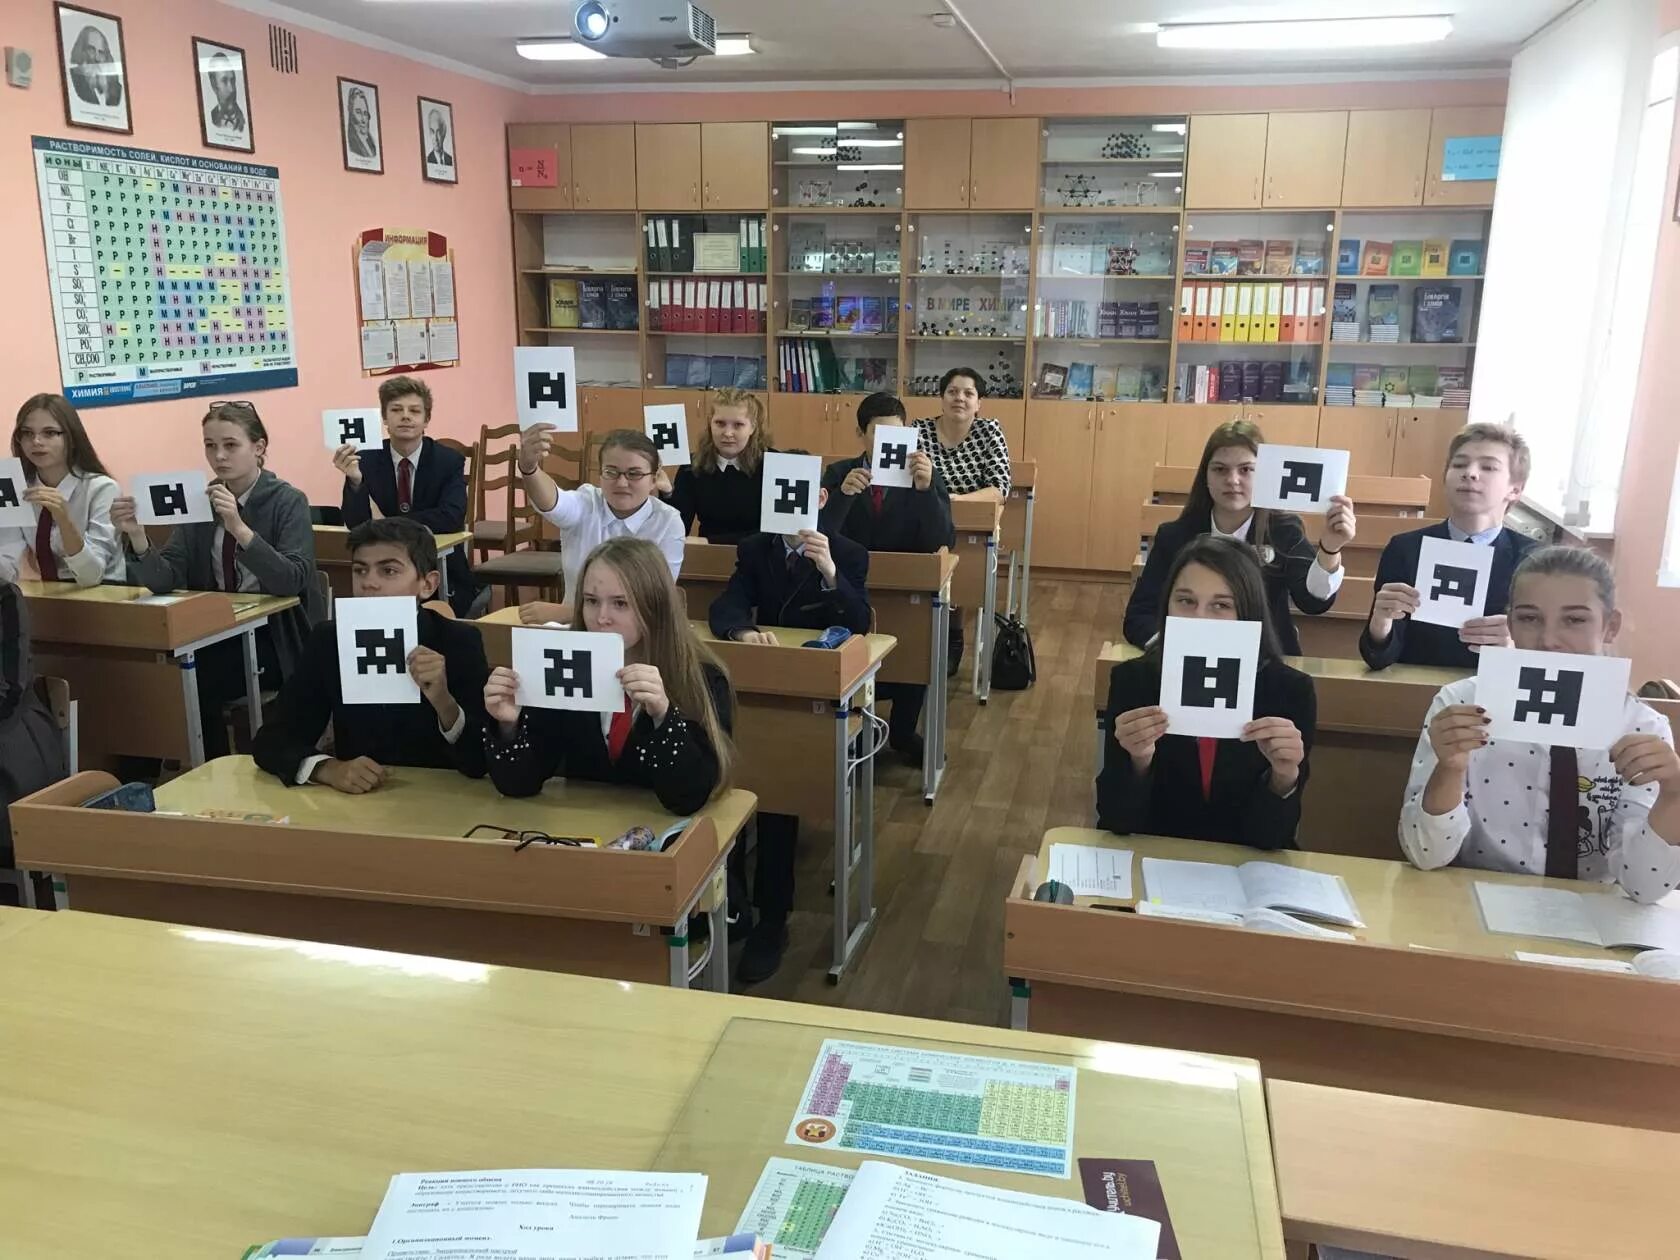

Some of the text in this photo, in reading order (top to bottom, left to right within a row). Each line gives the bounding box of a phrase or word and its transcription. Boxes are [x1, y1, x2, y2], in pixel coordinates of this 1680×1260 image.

[49, 140, 127, 158] РАСТВОРИМОСТЬ
[160, 154, 190, 166] КИСЛОТ
[192, 158, 198, 167] И
[198, 160, 242, 172] ОСНОВАНИЙ
[384, 234, 428, 244] ИНФОРМАЦИЯ
[927, 298, 934, 310] В
[72, 388, 104, 398] ХИМИЯ
